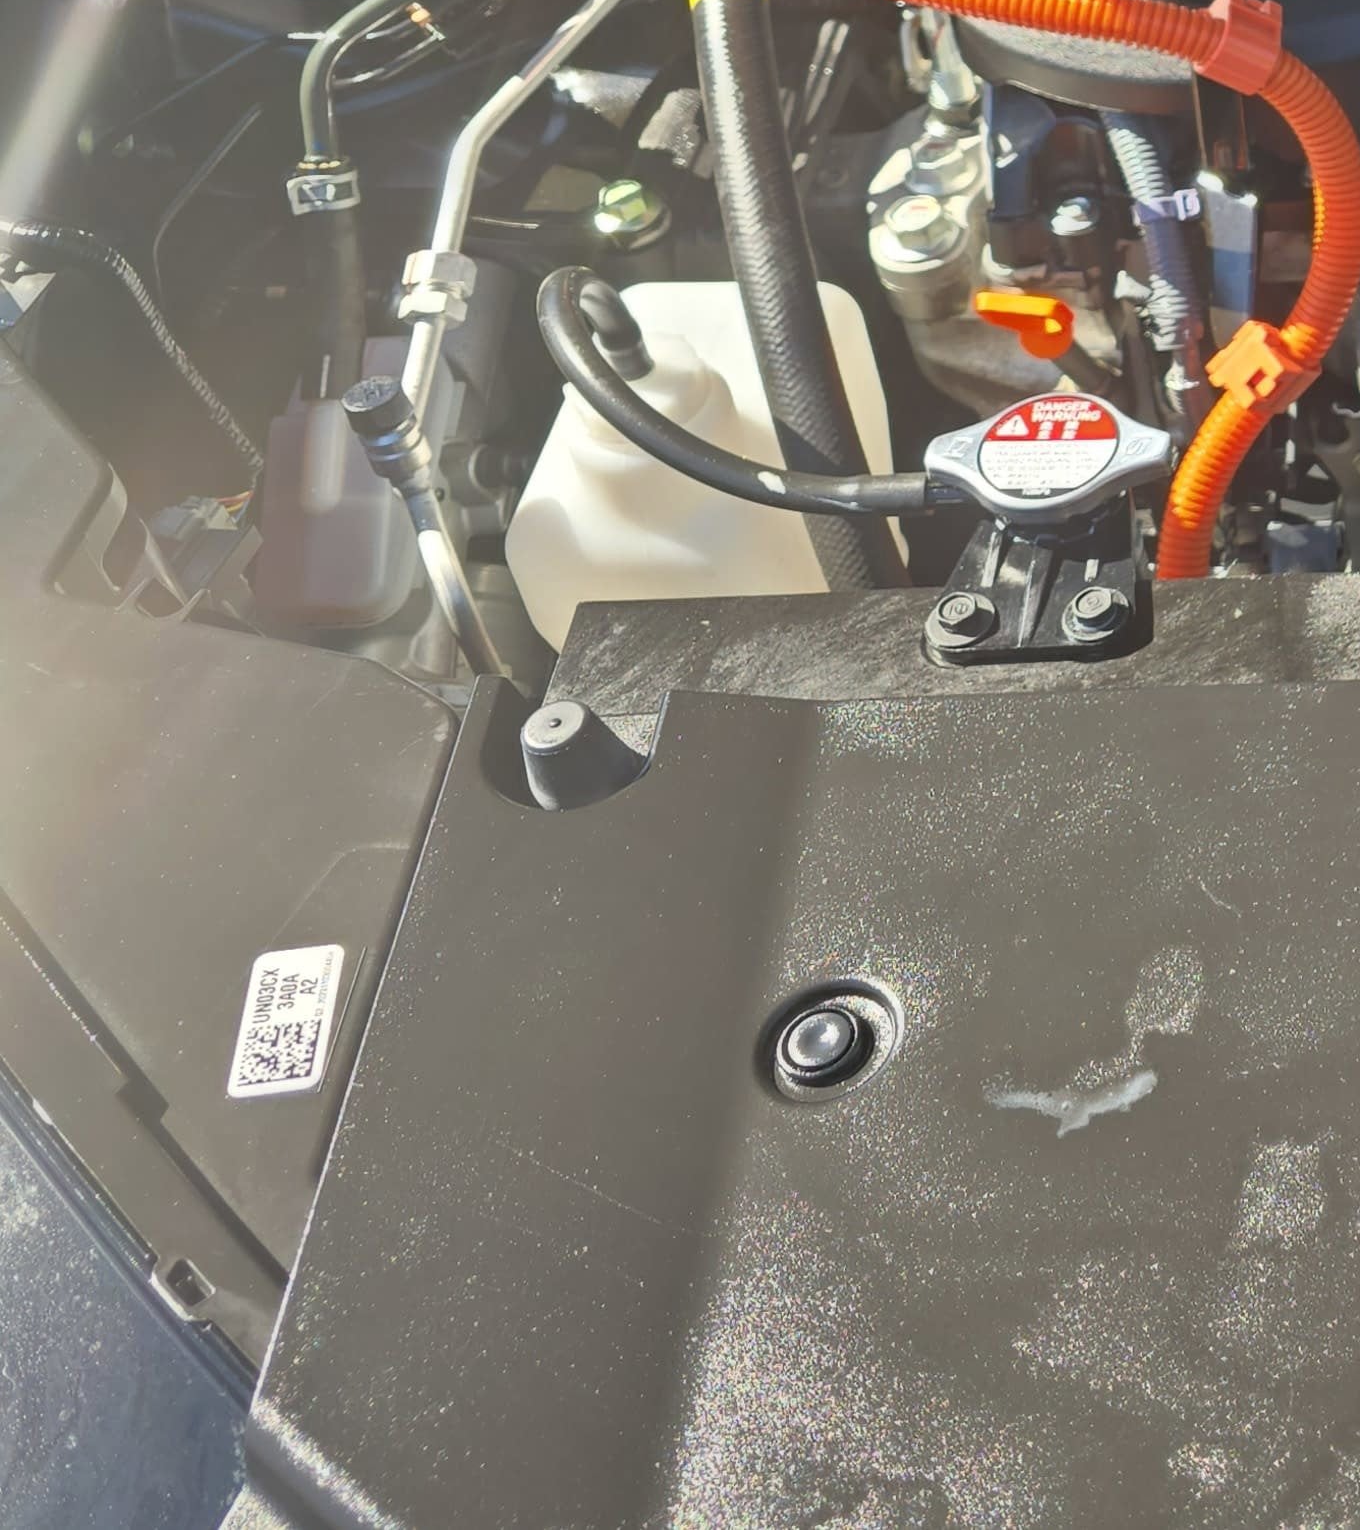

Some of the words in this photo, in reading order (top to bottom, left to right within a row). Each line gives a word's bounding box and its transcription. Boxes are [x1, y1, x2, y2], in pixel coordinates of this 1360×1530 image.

[252, 967, 280, 1024] UN03CX
[276, 973, 300, 1011] 3A0A
[299, 977, 319, 995] A2
